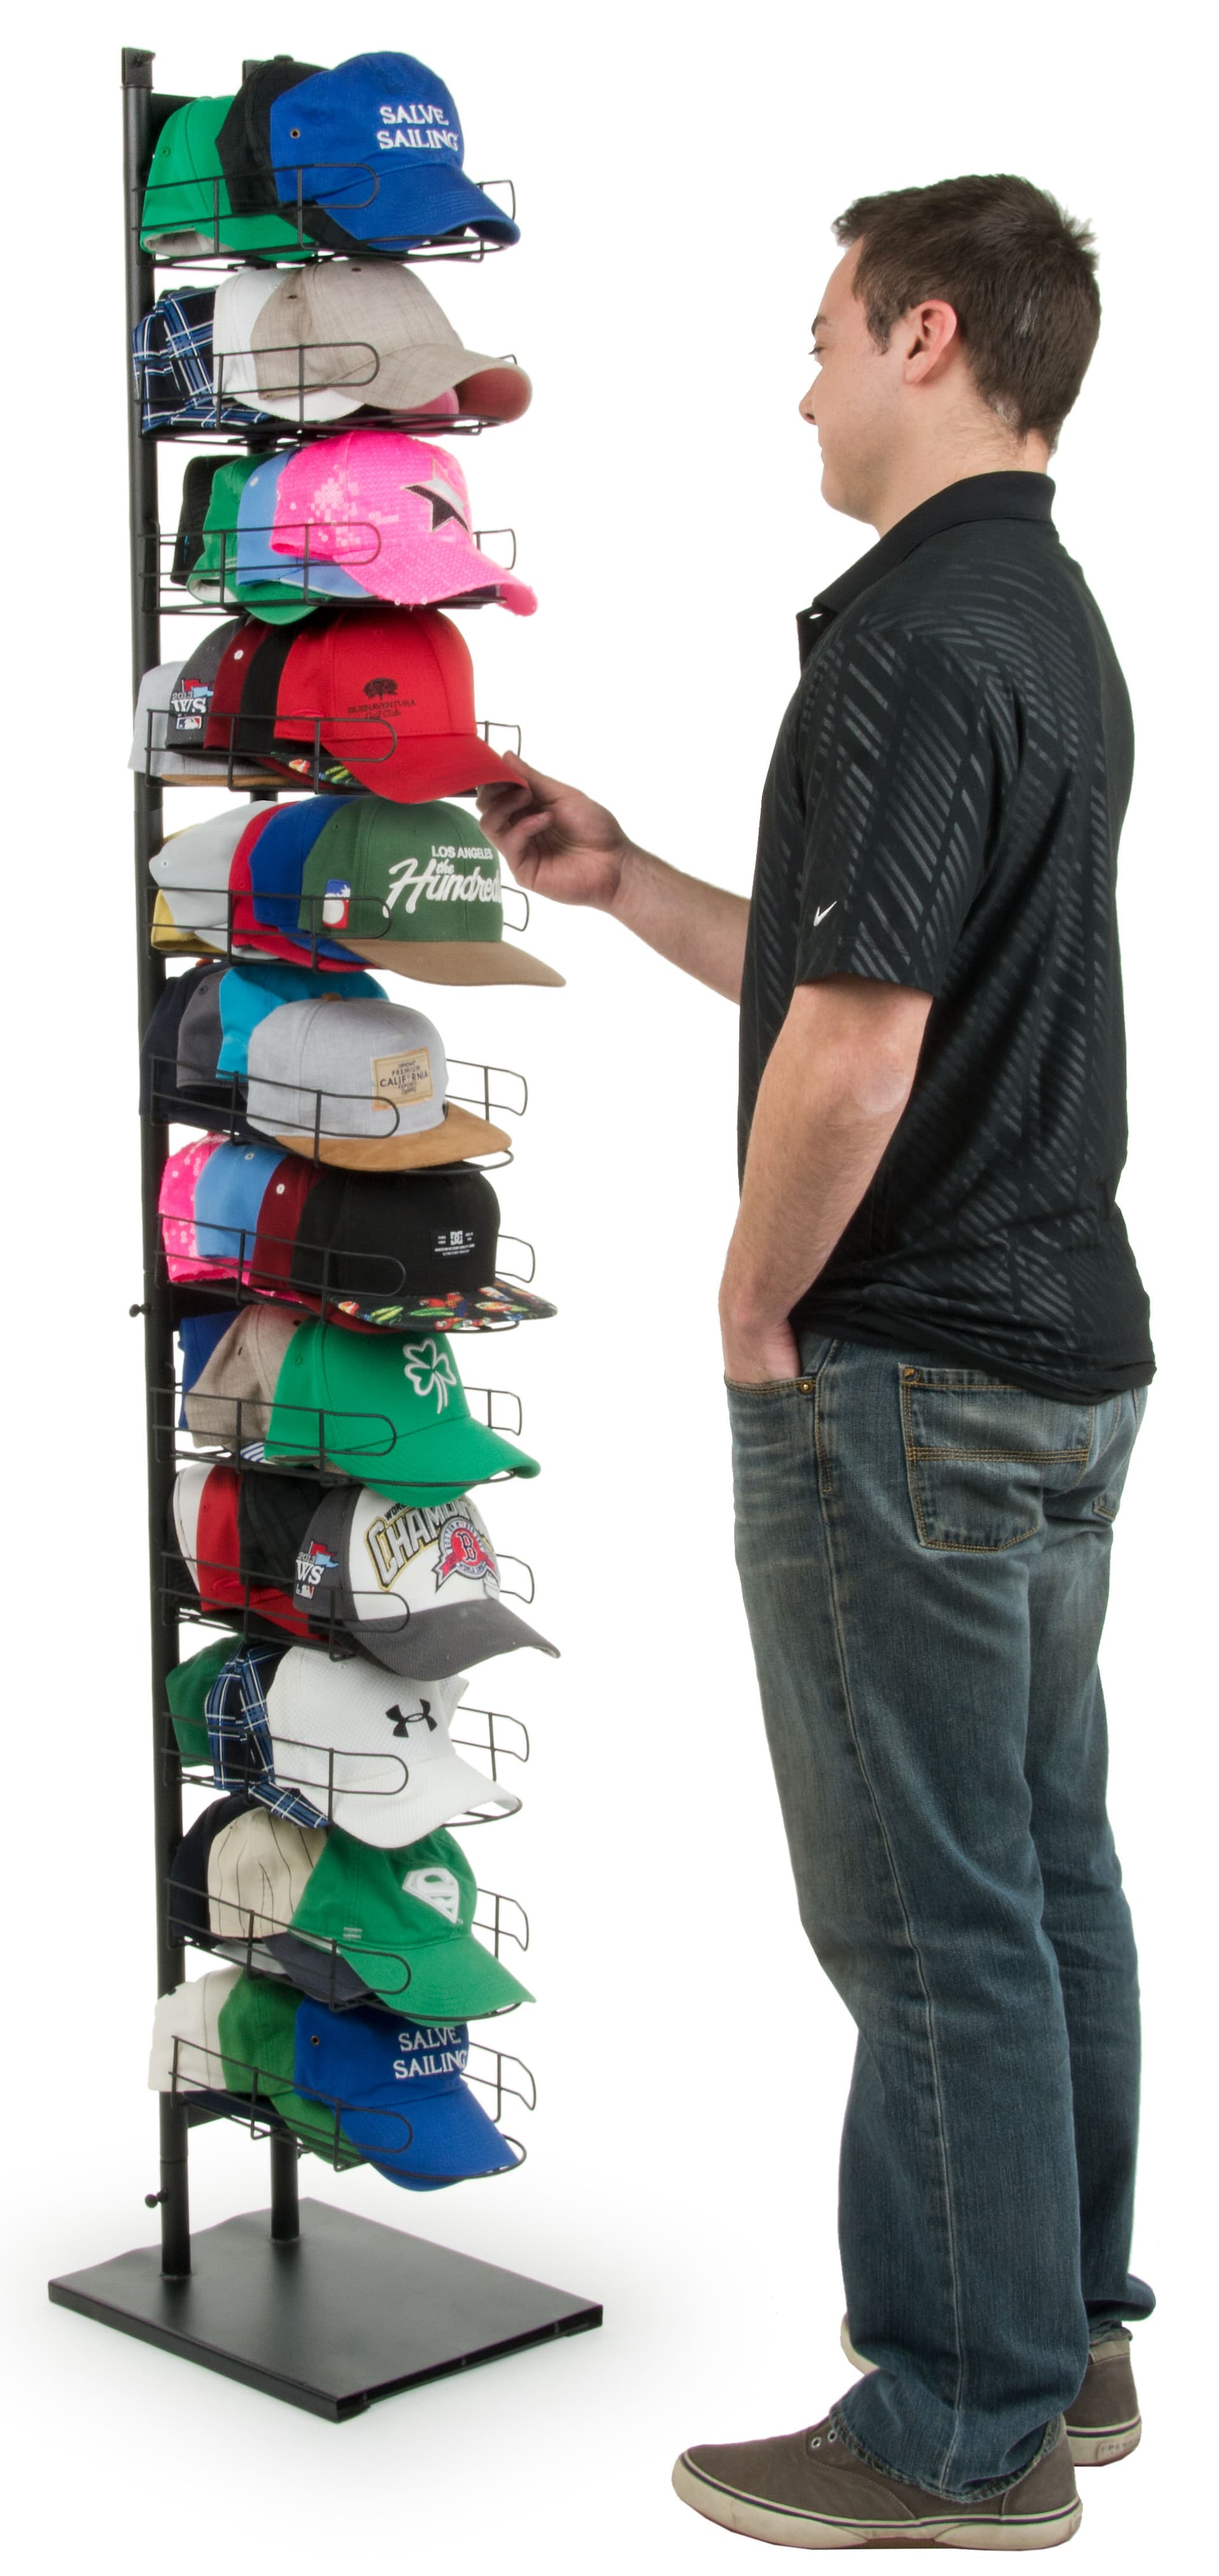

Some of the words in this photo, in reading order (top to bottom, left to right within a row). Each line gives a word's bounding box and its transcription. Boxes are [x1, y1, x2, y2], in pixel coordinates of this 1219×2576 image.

[380, 104, 449, 126] SALVE
[376, 128, 458, 152] SAILING
[171, 691, 193, 700] 2013
[171, 698, 206, 714] WS
[431, 846, 450, 858] LOS
[451, 847, 493, 860] ANGELES
[436, 858, 455, 874] the
[383, 858, 502, 919] Hundred
[450, 1230, 463, 1245] DC
[384, 1502, 408, 1521] WORL
[456, 1532, 477, 1562] B
[296, 1559, 325, 1585] WS
[398, 2026, 462, 2052] SALVE
[393, 2049, 468, 2079] SAILING
